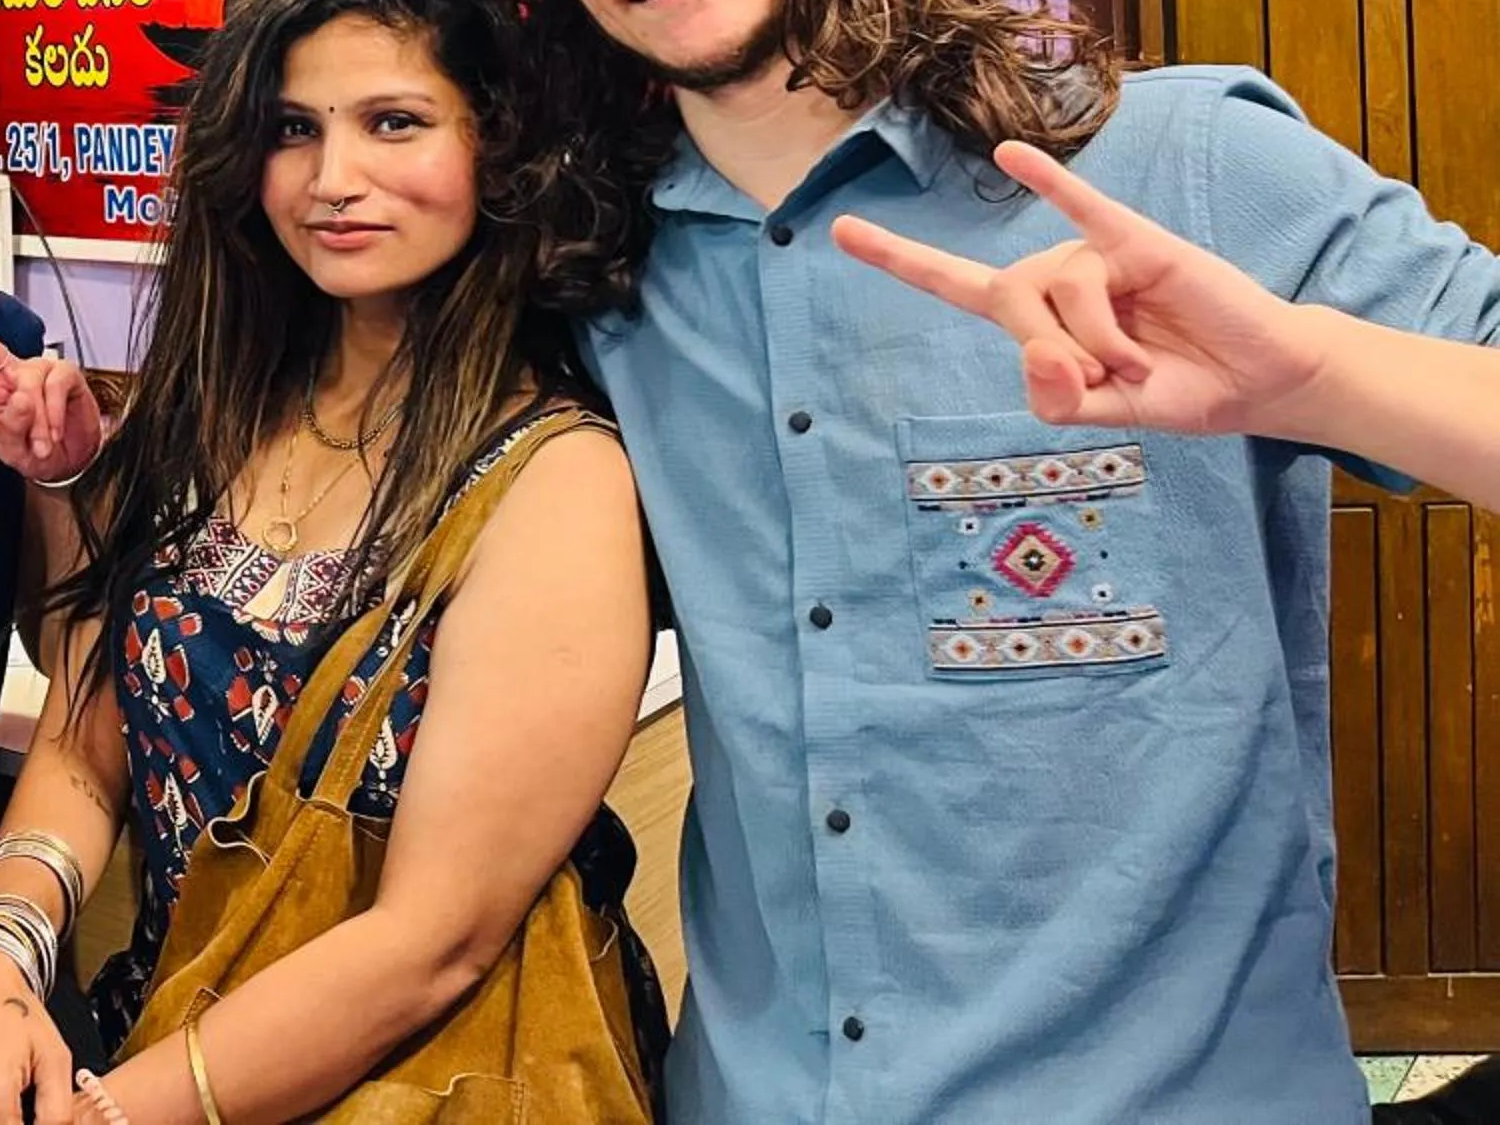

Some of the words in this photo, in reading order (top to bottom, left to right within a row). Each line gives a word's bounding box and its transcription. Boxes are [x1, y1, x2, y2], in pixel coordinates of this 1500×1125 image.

[25, 24, 110, 87] కలదు
[6, 121, 71, 180] 25/1,
[74, 124, 178, 175] PANDEY
